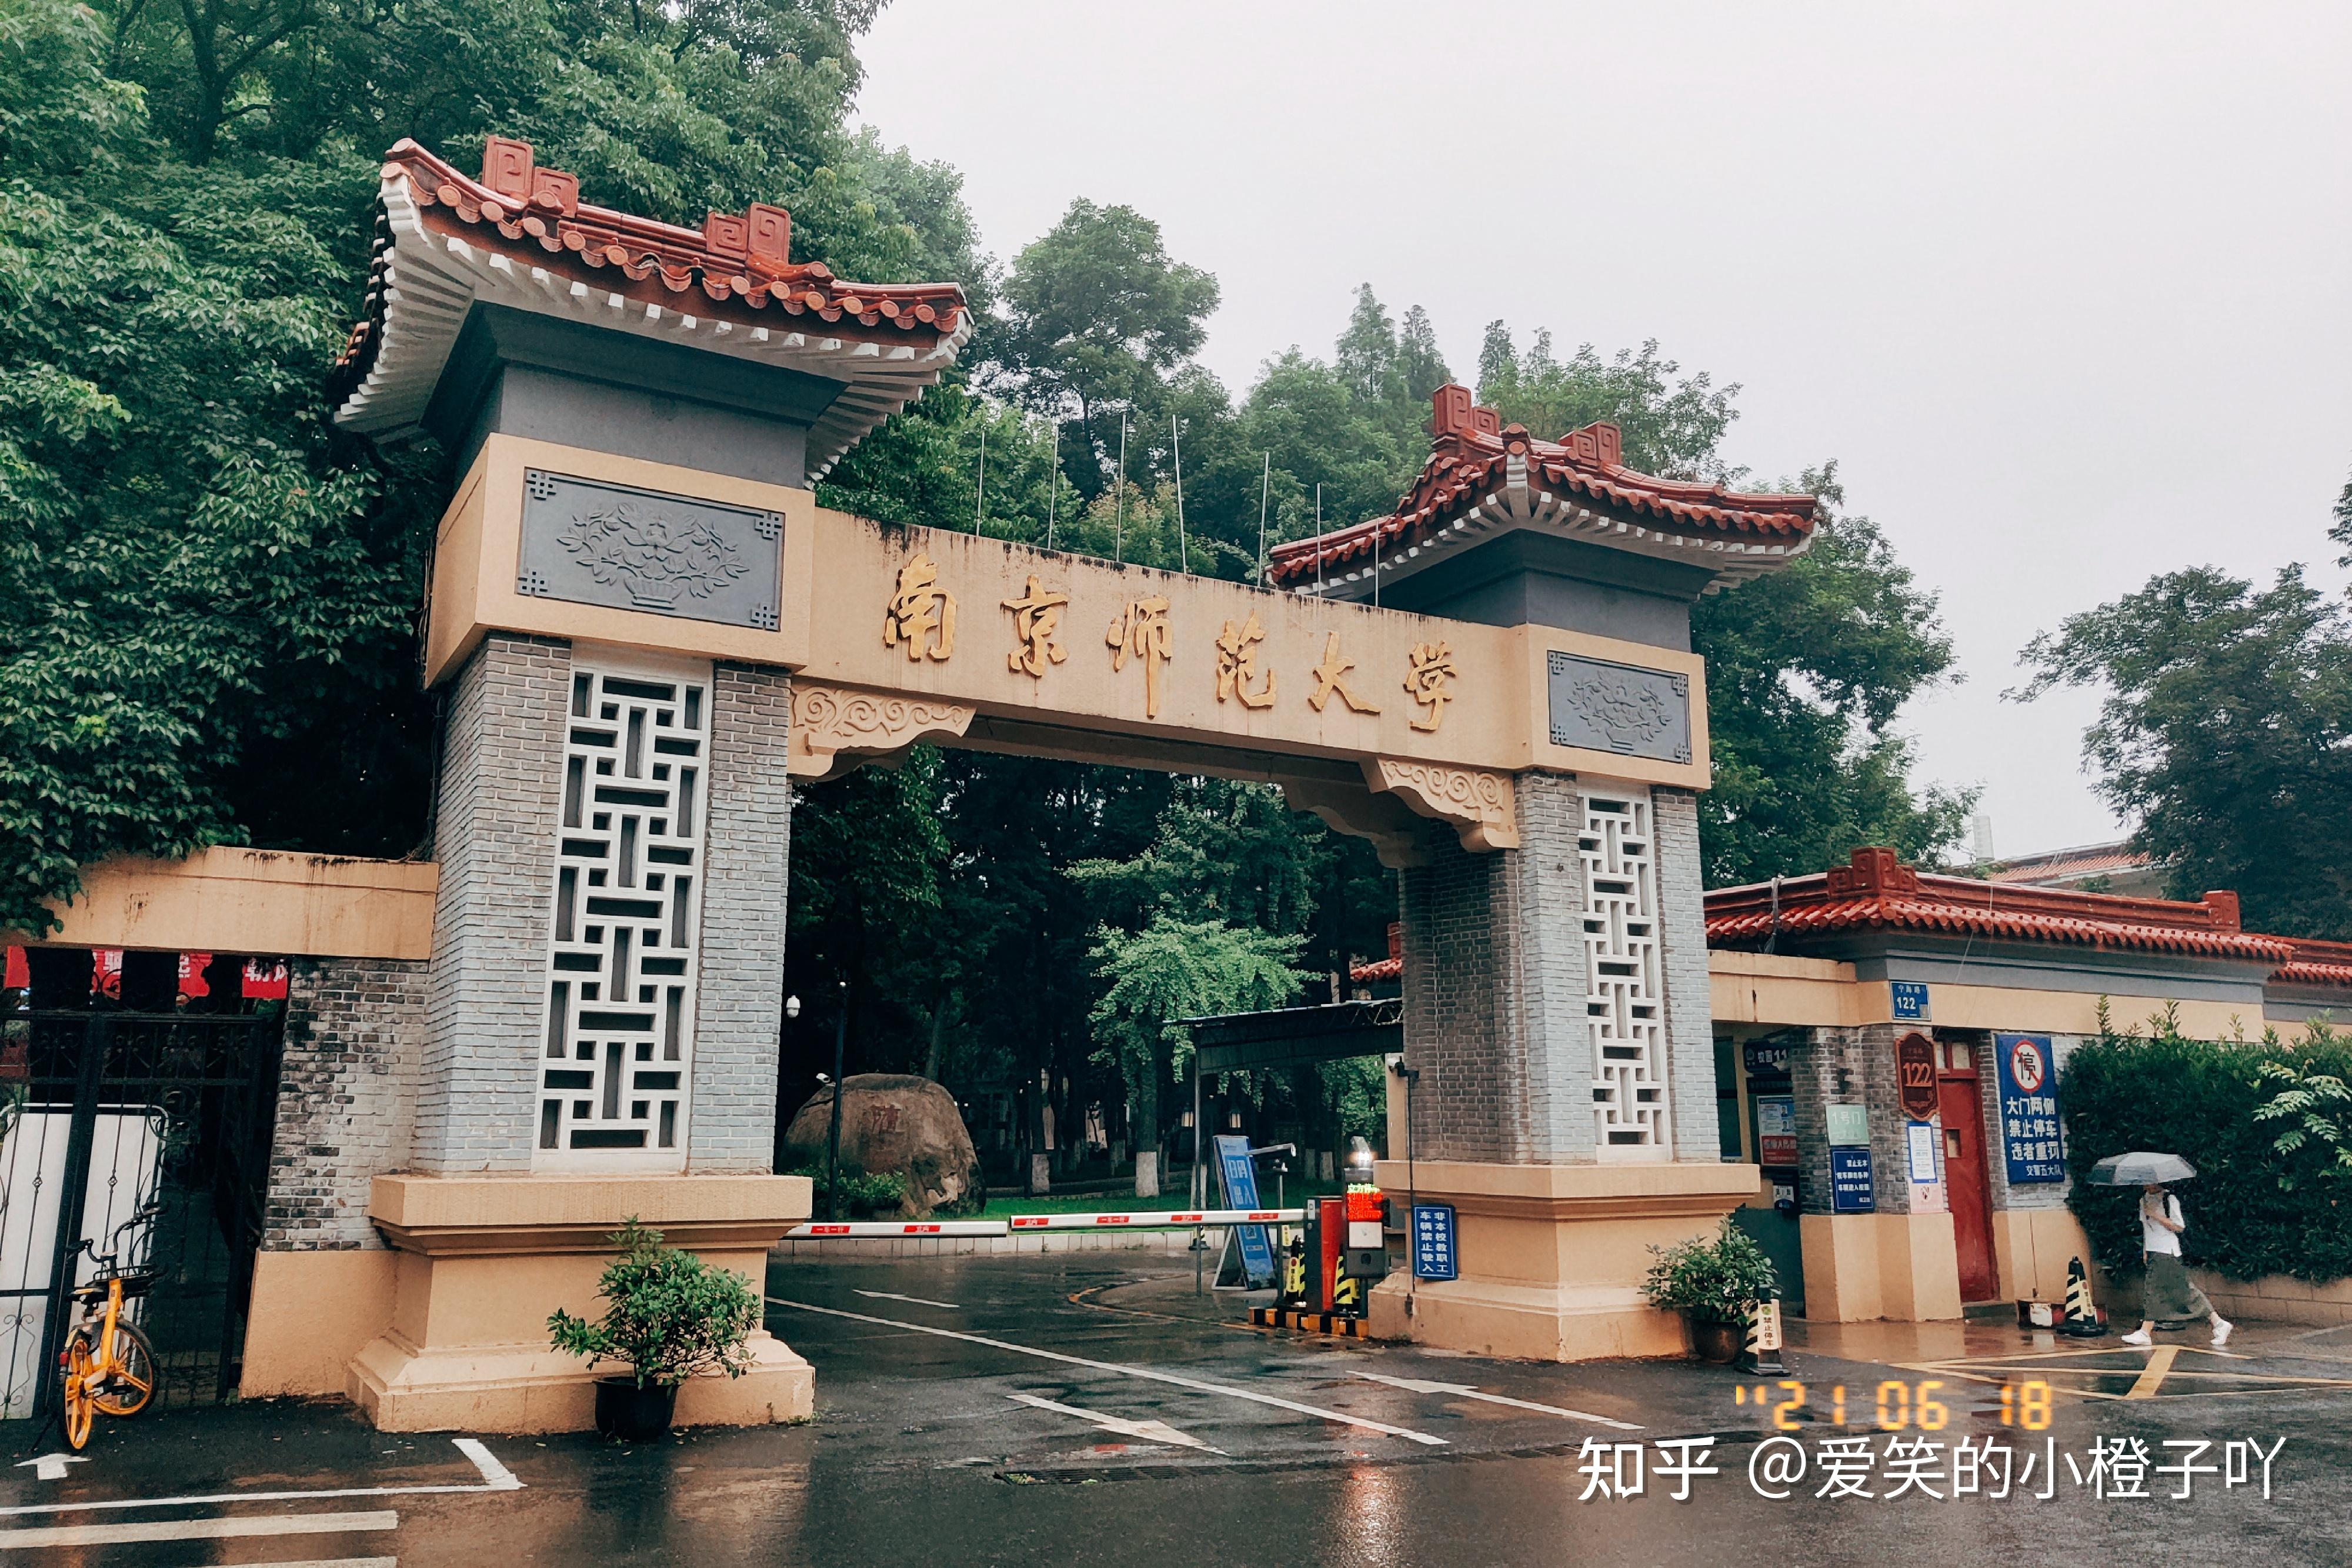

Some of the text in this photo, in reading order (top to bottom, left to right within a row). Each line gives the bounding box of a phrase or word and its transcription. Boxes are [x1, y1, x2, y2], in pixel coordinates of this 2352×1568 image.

[884, 553, 1457, 732] 南京师范大学
[1897, 996, 1916, 1010] 122
[1903, 1062, 1932, 1087] 122
[2006, 1096, 2056, 1116] 大门两侧
[1831, 1110, 1861, 1126] 1号门
[2008, 1118, 2058, 1139] 禁止停车
[2011, 1140, 2060, 1161] 违者重罚
[2026, 1163, 2063, 1176] 交警五大队
[1420, 1211, 1434, 1272] 车辆禁止驶入
[1434, 1212, 1449, 1273] 非本校教职工
[1763, 1317, 1774, 1346] 禁止停车
